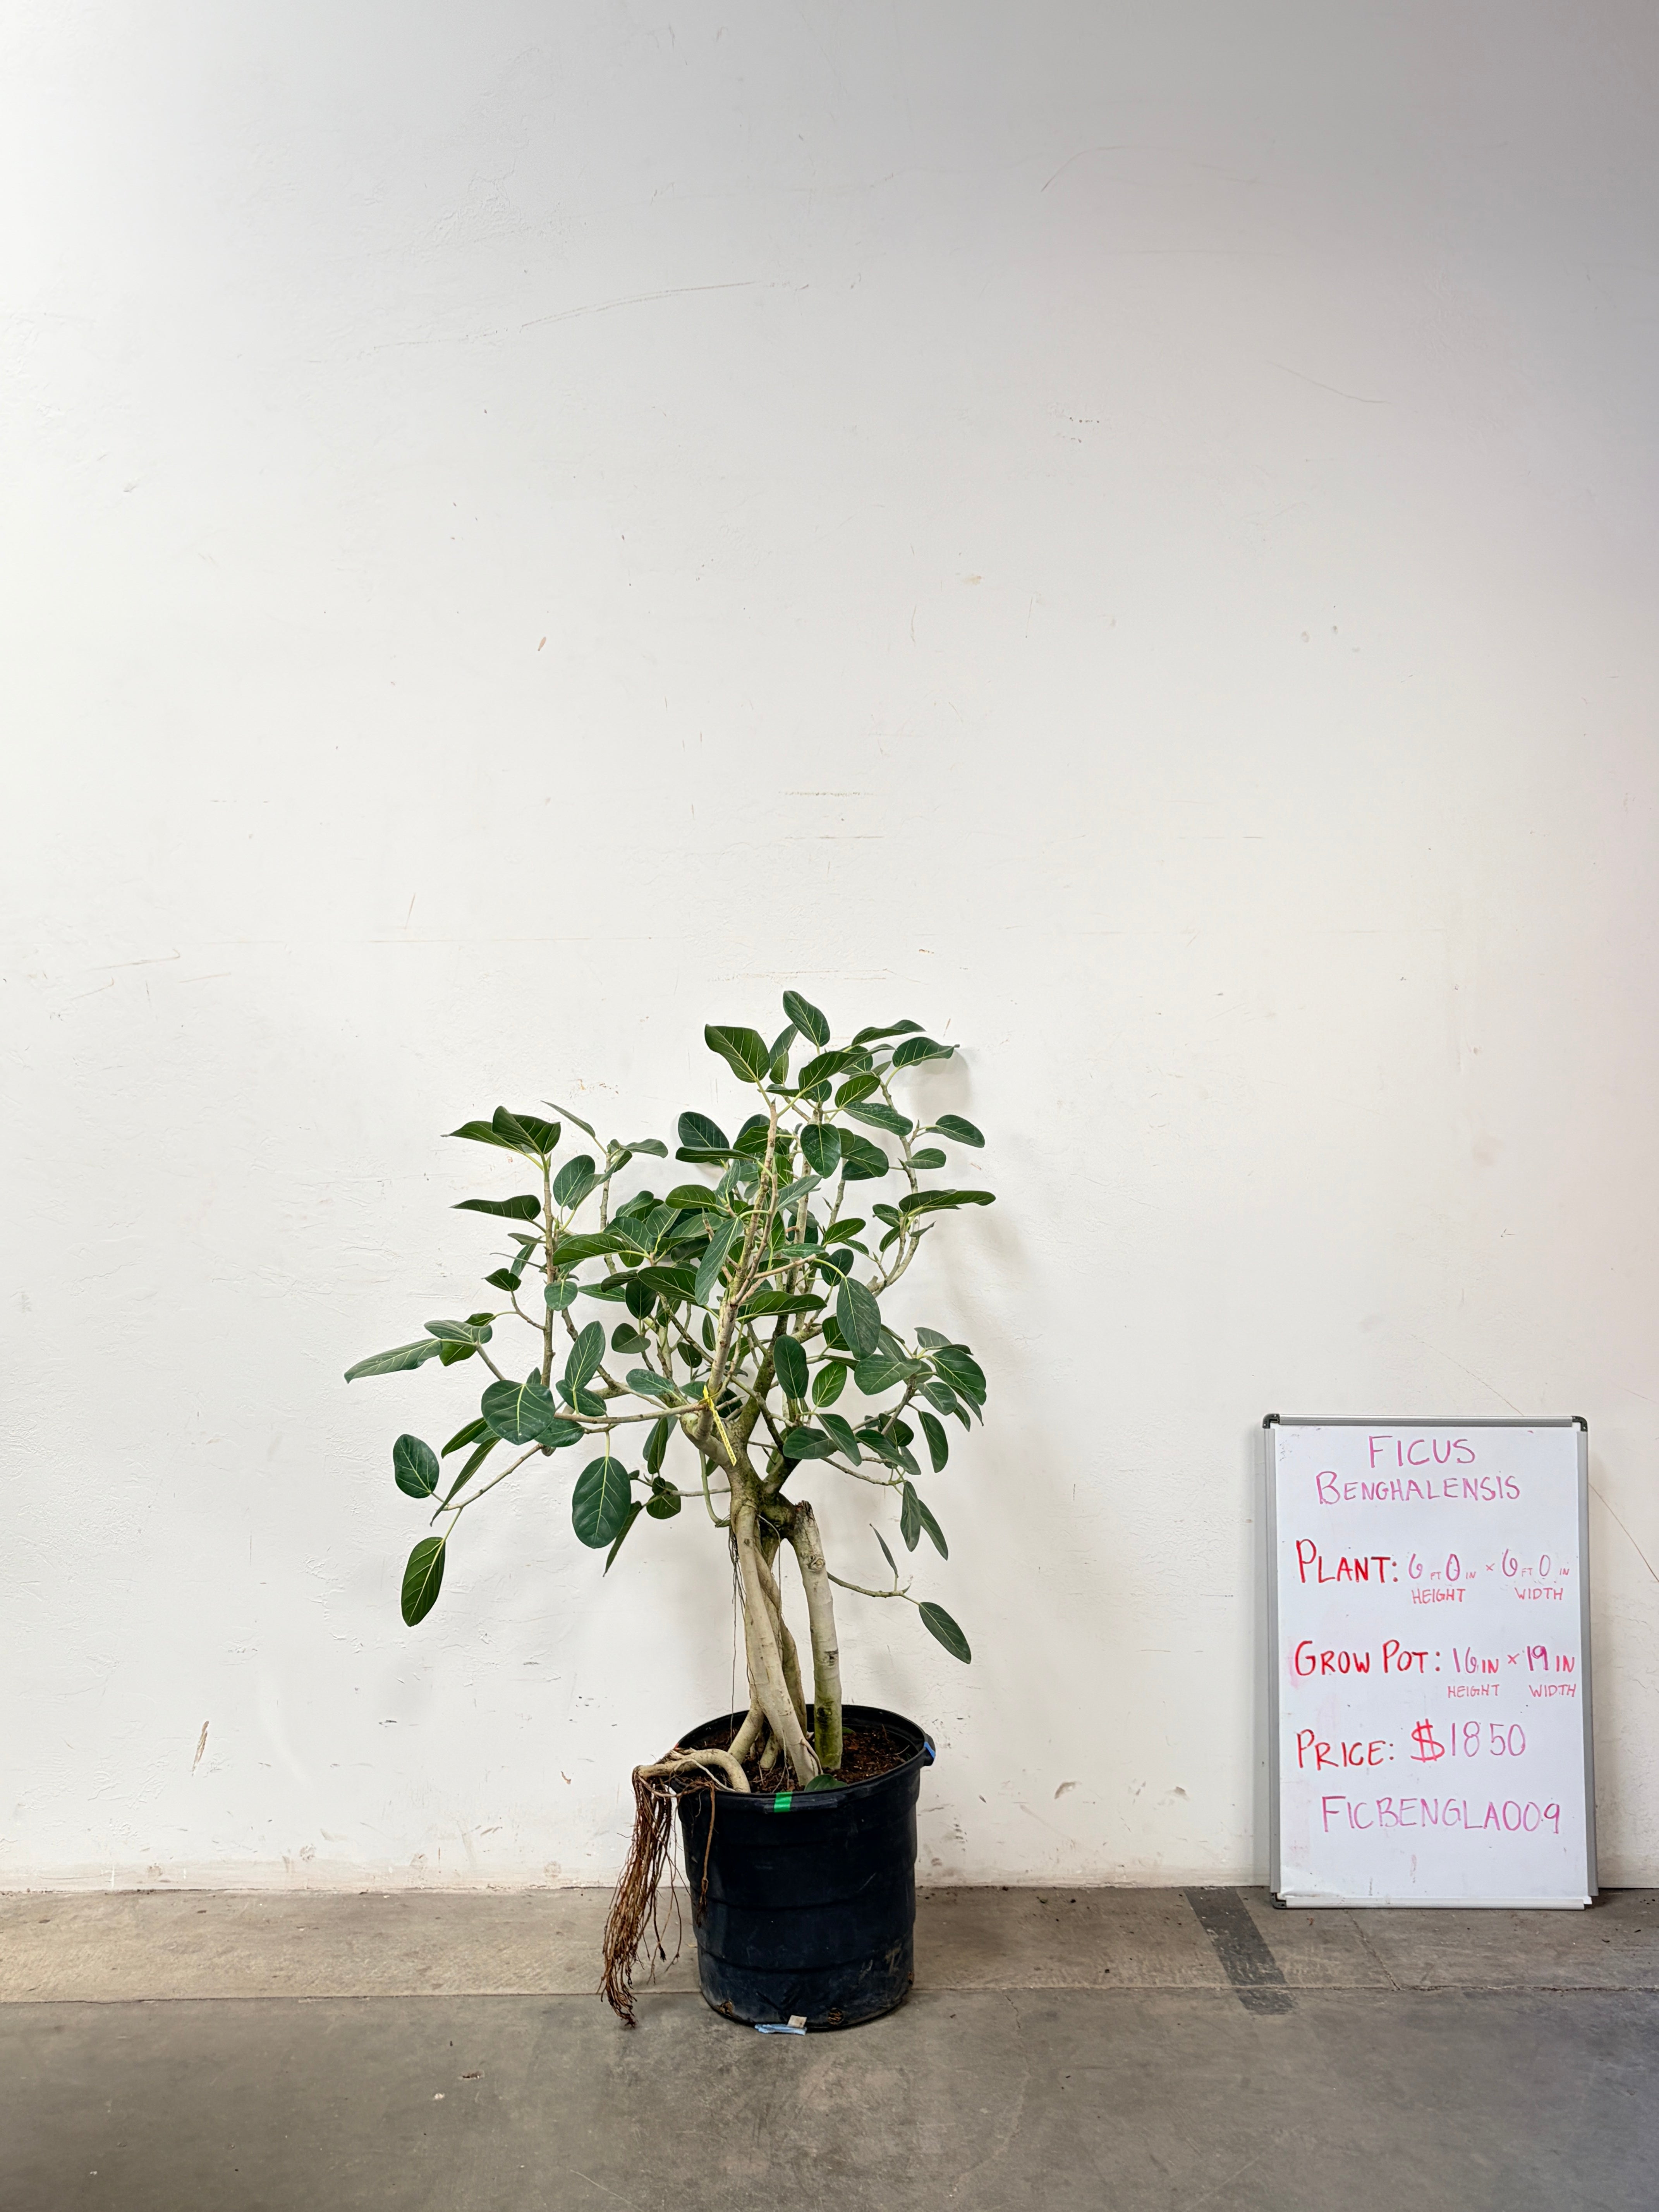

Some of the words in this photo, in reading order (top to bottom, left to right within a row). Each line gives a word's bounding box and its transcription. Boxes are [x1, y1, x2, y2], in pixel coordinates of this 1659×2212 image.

[1368, 1435, 1475, 1468] FICUS
[1316, 1470, 1521, 1504] BENGHALENSIS
[1296, 1539, 1398, 1583] PLANT:
[1408, 1554, 1423, 1579] 6
[1466, 1571, 1476, 1580] IN
[1502, 1549, 1518, 1578] 6
[1559, 1568, 1570, 1576] IN
[1412, 1589, 1466, 1604] HEIGHT
[1515, 1588, 1563, 1601] WIDTH
[1295, 1640, 1370, 1676] GROW
[1383, 1639, 1441, 1673] POT:
[1453, 1647, 1477, 1673] 16
[1482, 1658, 1499, 1674] IN
[1527, 1645, 1548, 1671] 19
[1556, 1655, 1575, 1673] IN
[1448, 1684, 1500, 1698] HEIGHT
[1529, 1684, 1576, 1697] WIDTH
[1296, 1729, 1394, 1770] PRICE:
[1410, 1719, 1526, 1763] $1850
[1322, 1796, 1560, 1834] FICBENGLA009
